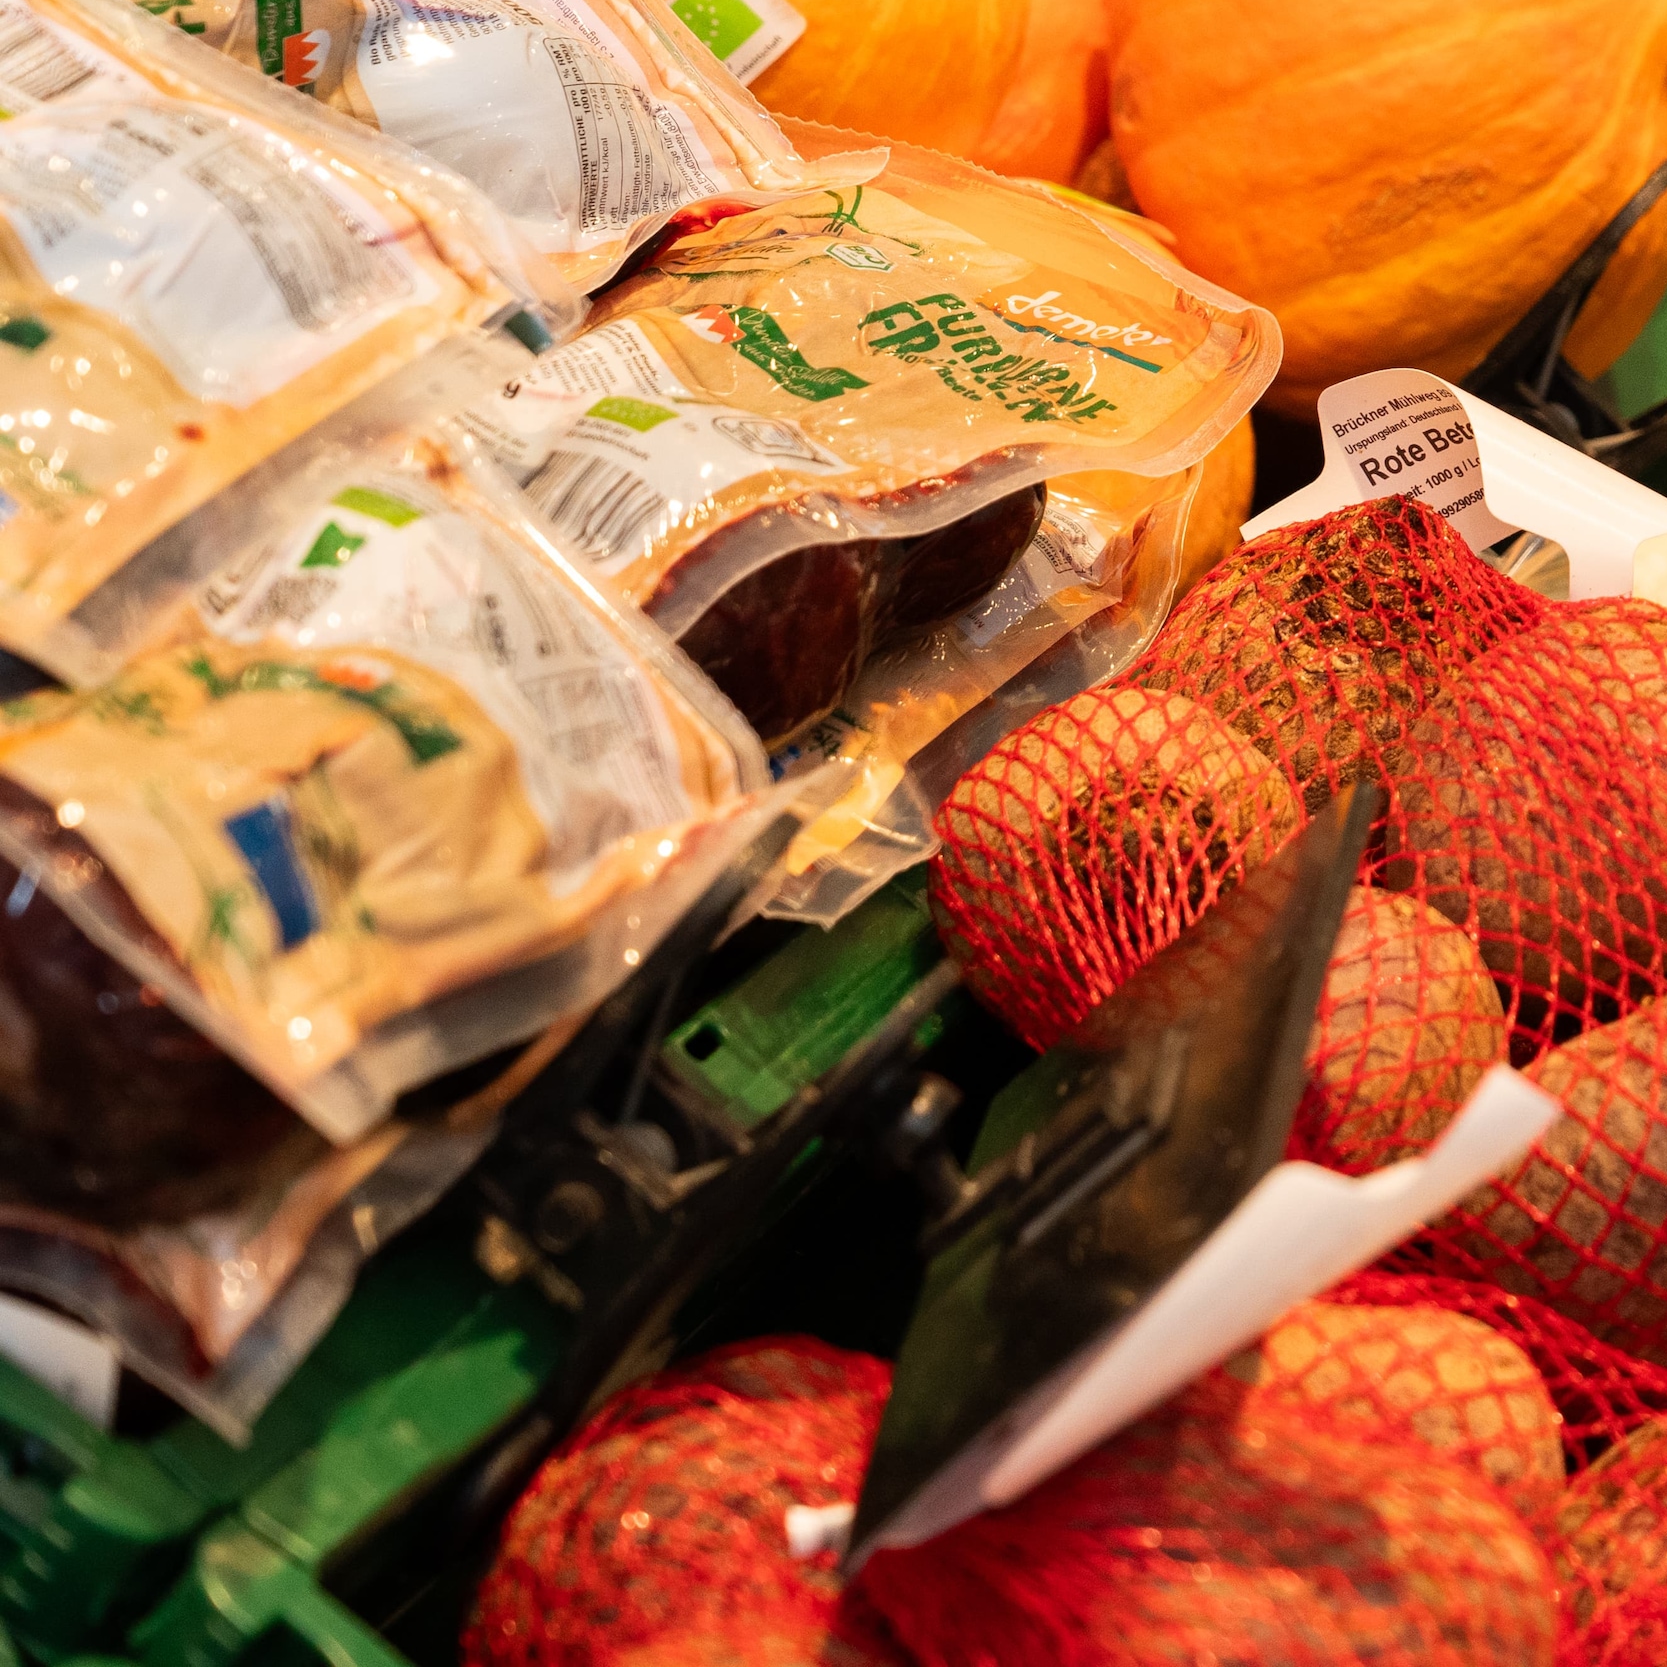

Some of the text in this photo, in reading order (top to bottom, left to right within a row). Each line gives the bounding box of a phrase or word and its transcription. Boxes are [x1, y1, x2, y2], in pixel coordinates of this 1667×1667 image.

[570, 89, 581, 107] pro
[591, 87, 604, 121] 177/42
[601, 137, 610, 174] kJ/kcal
[620, 192, 632, 225] davon:
[1006, 290, 1173, 347] demeter
[1332, 404, 1389, 438] Brückner
[1388, 389, 1442, 413] Mühlweg
[1344, 404, 1459, 456] Urspungsland: Deutschland
[1359, 442, 1427, 487] Rote
[1425, 468, 1454, 490] 1000
[1452, 464, 1465, 478] g
